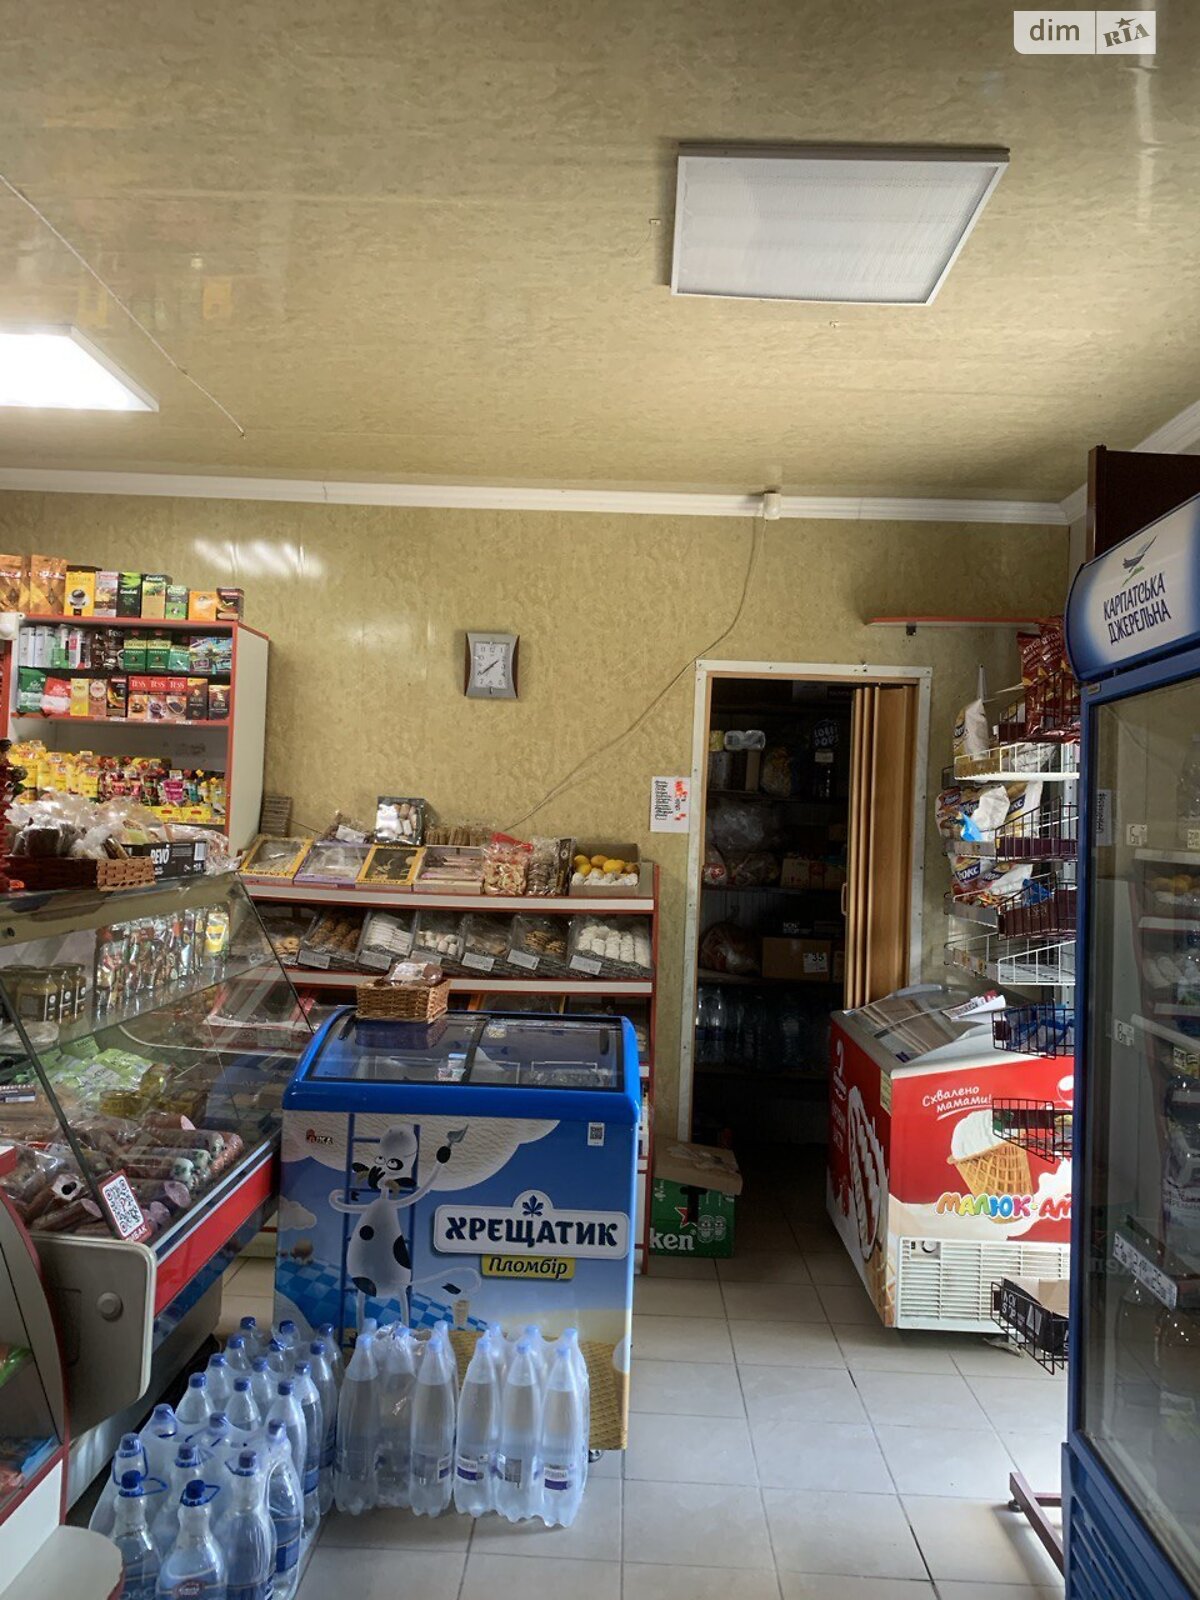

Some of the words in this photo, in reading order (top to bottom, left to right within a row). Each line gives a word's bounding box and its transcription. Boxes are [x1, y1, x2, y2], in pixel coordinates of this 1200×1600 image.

[1103, 572, 1166, 621] КАРПАТСЬКА
[1108, 599, 1172, 645] ДЖЕРЕЛЬНА
[922, 1086, 980, 1107] Схвалено
[936, 1094, 992, 1113] мамами!
[446, 1217, 618, 1248] ХРЕЩАТИК
[487, 1257, 568, 1280] Пломбір
